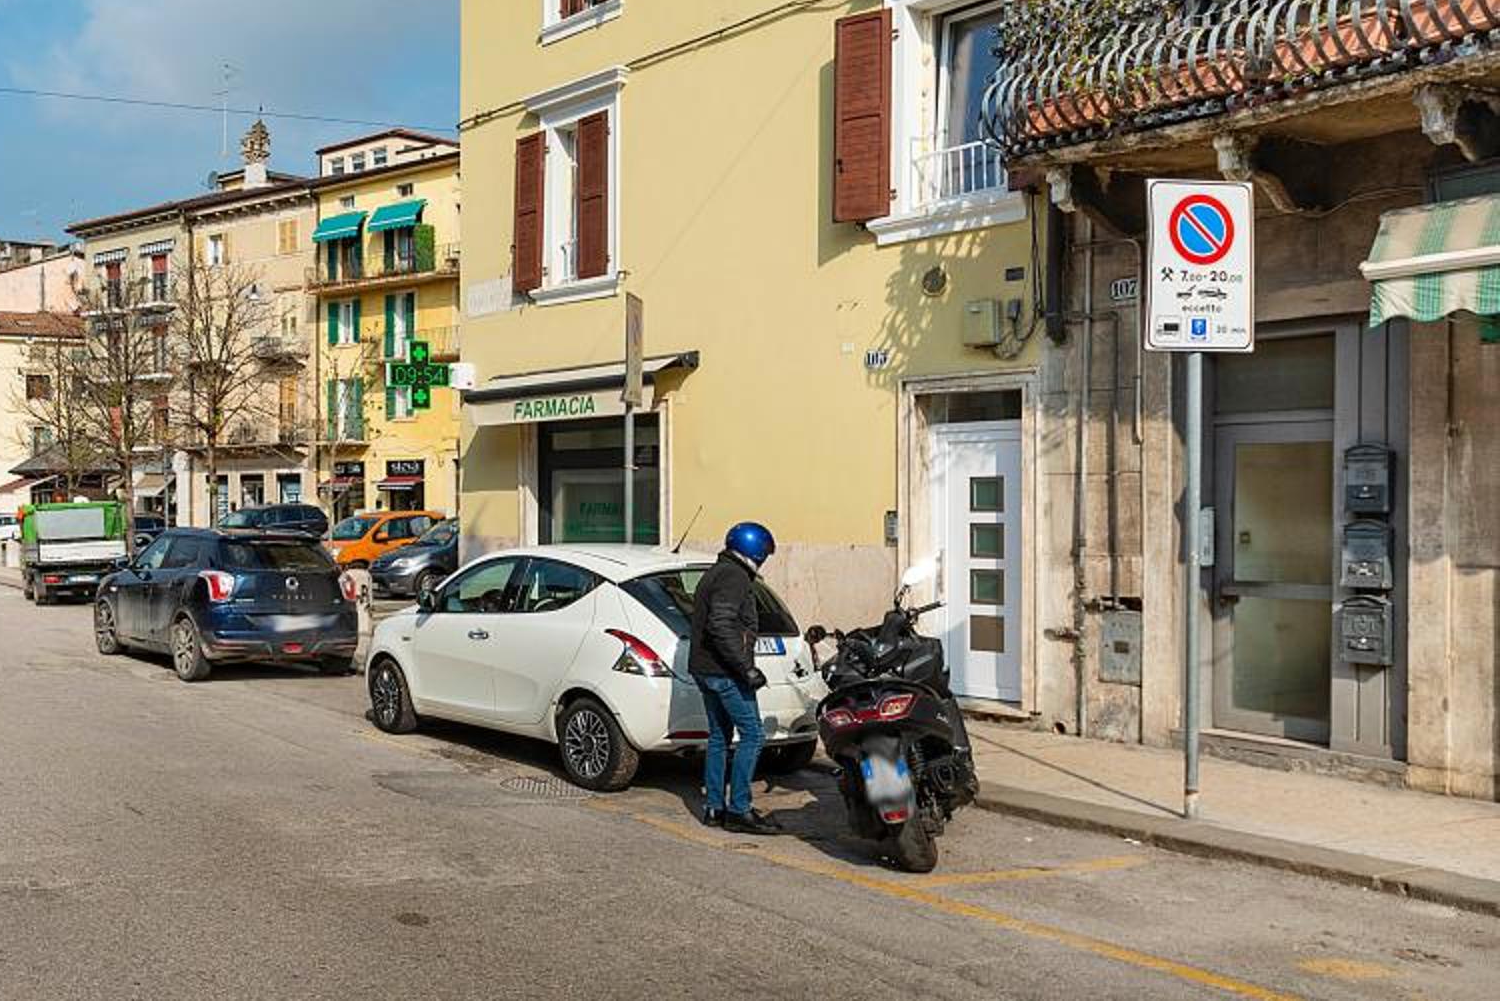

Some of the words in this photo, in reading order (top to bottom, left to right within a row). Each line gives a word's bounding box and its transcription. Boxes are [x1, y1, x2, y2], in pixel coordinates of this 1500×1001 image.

[1113, 280, 1137, 297] 107
[395, 366, 443, 384] 09:54
[513, 395, 596, 420] FARMACIA
